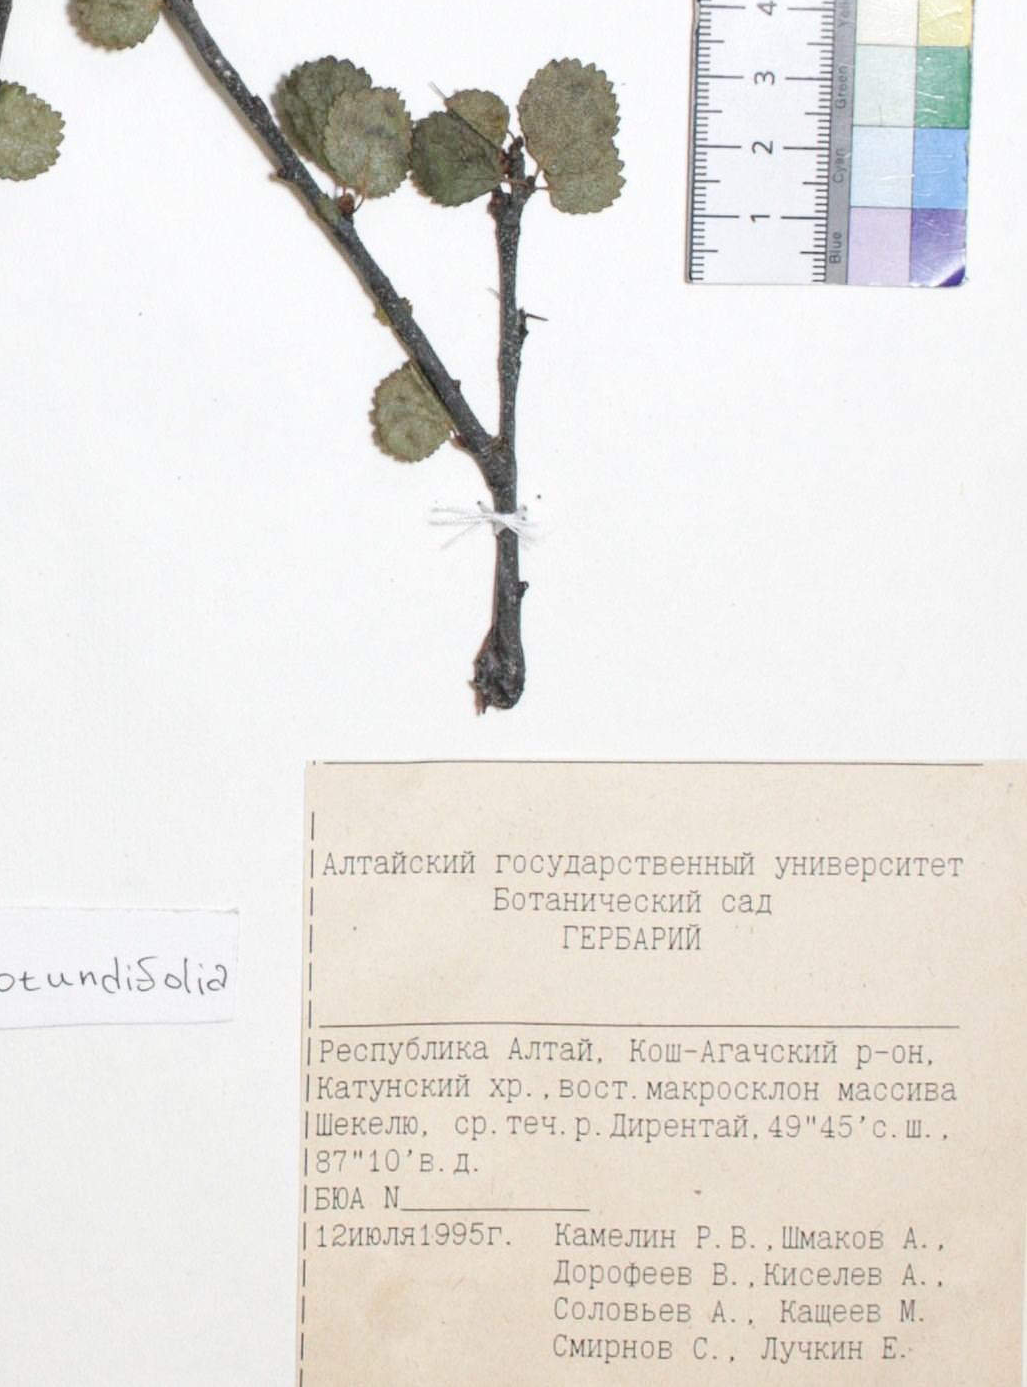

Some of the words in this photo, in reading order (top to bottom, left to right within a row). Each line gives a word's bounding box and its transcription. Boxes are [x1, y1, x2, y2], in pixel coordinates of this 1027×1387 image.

[756, 0, 778, 16] 4
[753, 70, 776, 86] 3
[835, 63, 850, 110] Green
[751, 139, 774, 155] 2
[832, 147, 850, 184] Cyan
[749, 213, 771, 223] 1
[828, 230, 843, 264] Blue
[321, 850, 476, 877] Алтайский
[494, 851, 756, 881] государственный
[773, 853, 965, 883] университет
[492, 887, 703, 914] Ботанический
[720, 894, 774, 917] сад
[561, 925, 703, 953] ГЕРБАРИЙ
[319, 1037, 490, 1065] Республика
[508, 1037, 603, 1064] Алтай,
[629, 1039, 839, 1065] Кош-Агачский
[855, 1043, 935, 1070] р-он,
[316, 1074, 471, 1103] Катунский
[838, 1080, 958, 1102] массива
[315, 1112, 429, 1139] Шекелю,
[315, 1187, 365, 1211] БЮА
[554, 1223, 676, 1249] Камелин
[902, 1226, 945, 1252] А.,
[553, 1259, 693, 1290] Дорофеев
[901, 1263, 944, 1288] А.,
[553, 1297, 692, 1322] Соловьев
[711, 1300, 754, 1327] А.,
[779, 1299, 882, 1327] Кащеев
[899, 1299, 925, 1324] М.
[552, 1334, 673, 1364] Смирнов
[692, 1337, 736, 1364] С.,
[760, 1336, 863, 1364] Лучкин
[881, 1336, 907, 1361] Е.
